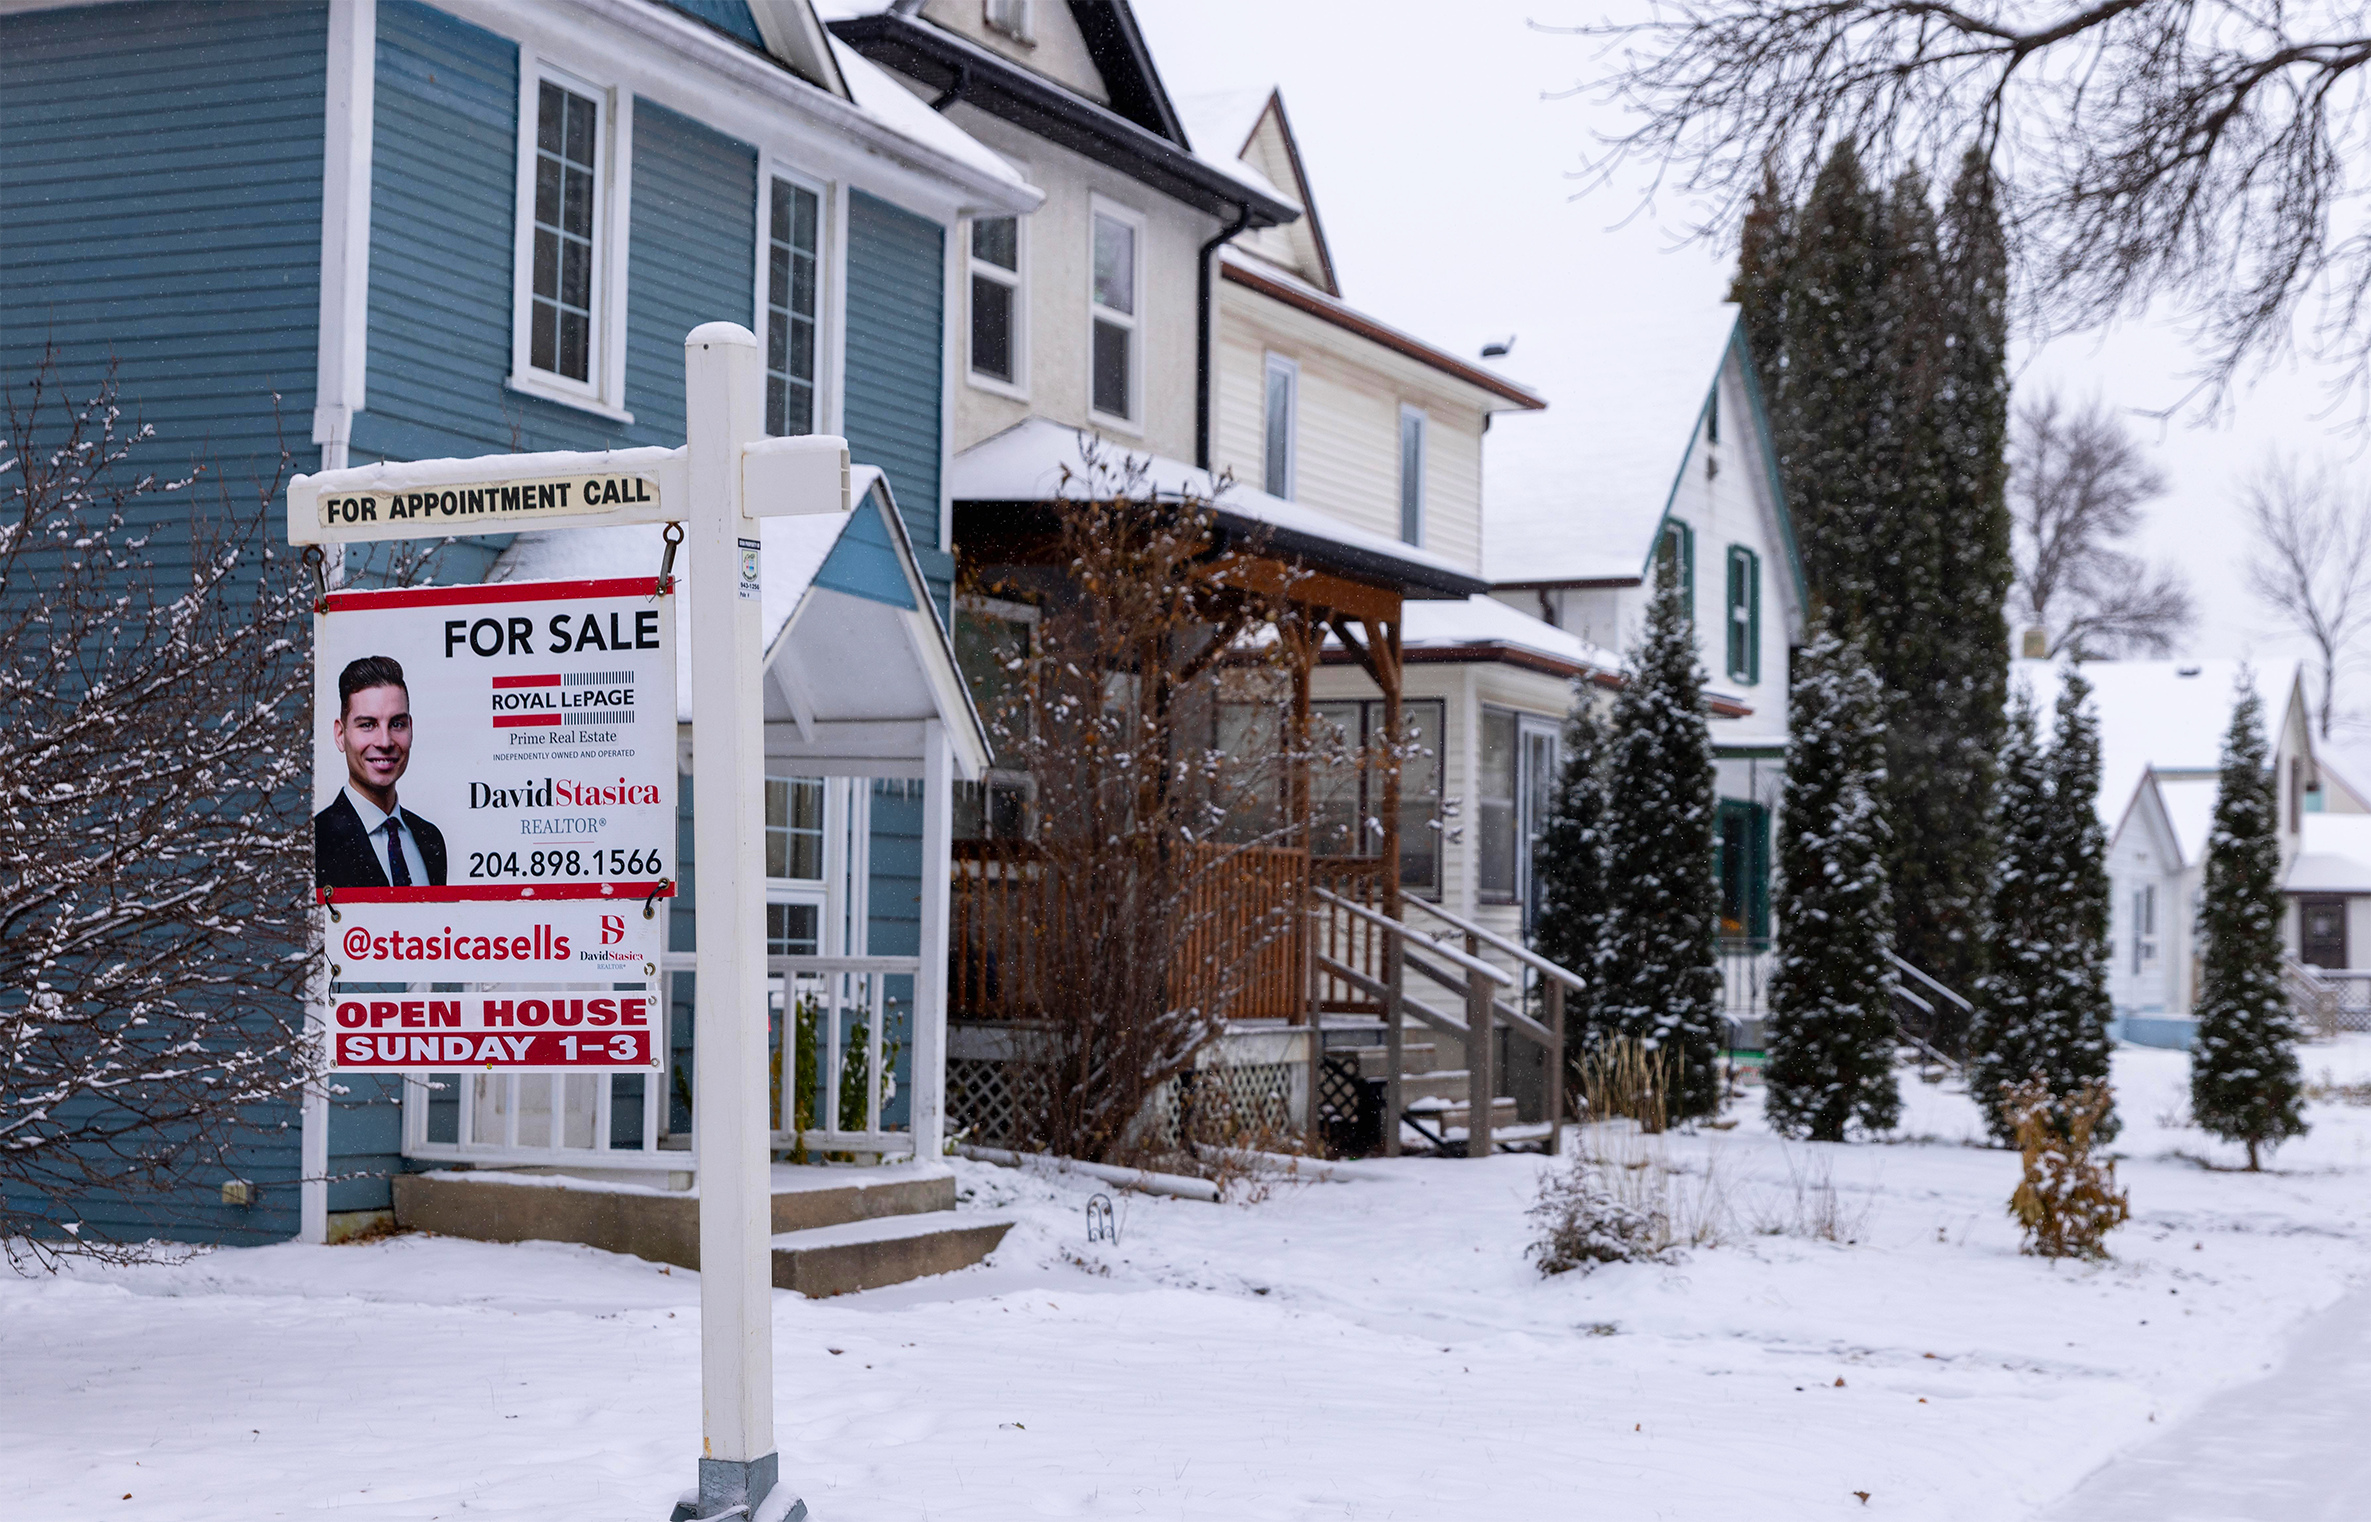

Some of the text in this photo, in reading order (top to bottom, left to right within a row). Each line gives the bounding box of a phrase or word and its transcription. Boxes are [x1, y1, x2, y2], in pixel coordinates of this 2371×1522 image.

[327, 477, 651, 523] FOR APPOINTMENT CALL
[740, 581, 760, 590] 943-1256
[445, 610, 660, 658] FOR SALE
[492, 692, 557, 710] ROYAL
[510, 730, 617, 745] Prime Real Estate
[493, 749, 635, 761] INDEPENDENTLY OWNED AND OPERATED
[468, 777, 661, 809] DavidStasica
[469, 848, 662, 878] 204.898.1566
[343, 924, 571, 961] @stasicasells
[580, 950, 644, 961] DavidStasica
[335, 998, 648, 1028] OPEN HOUSE
[344, 1035, 537, 1062] SUNDAY
